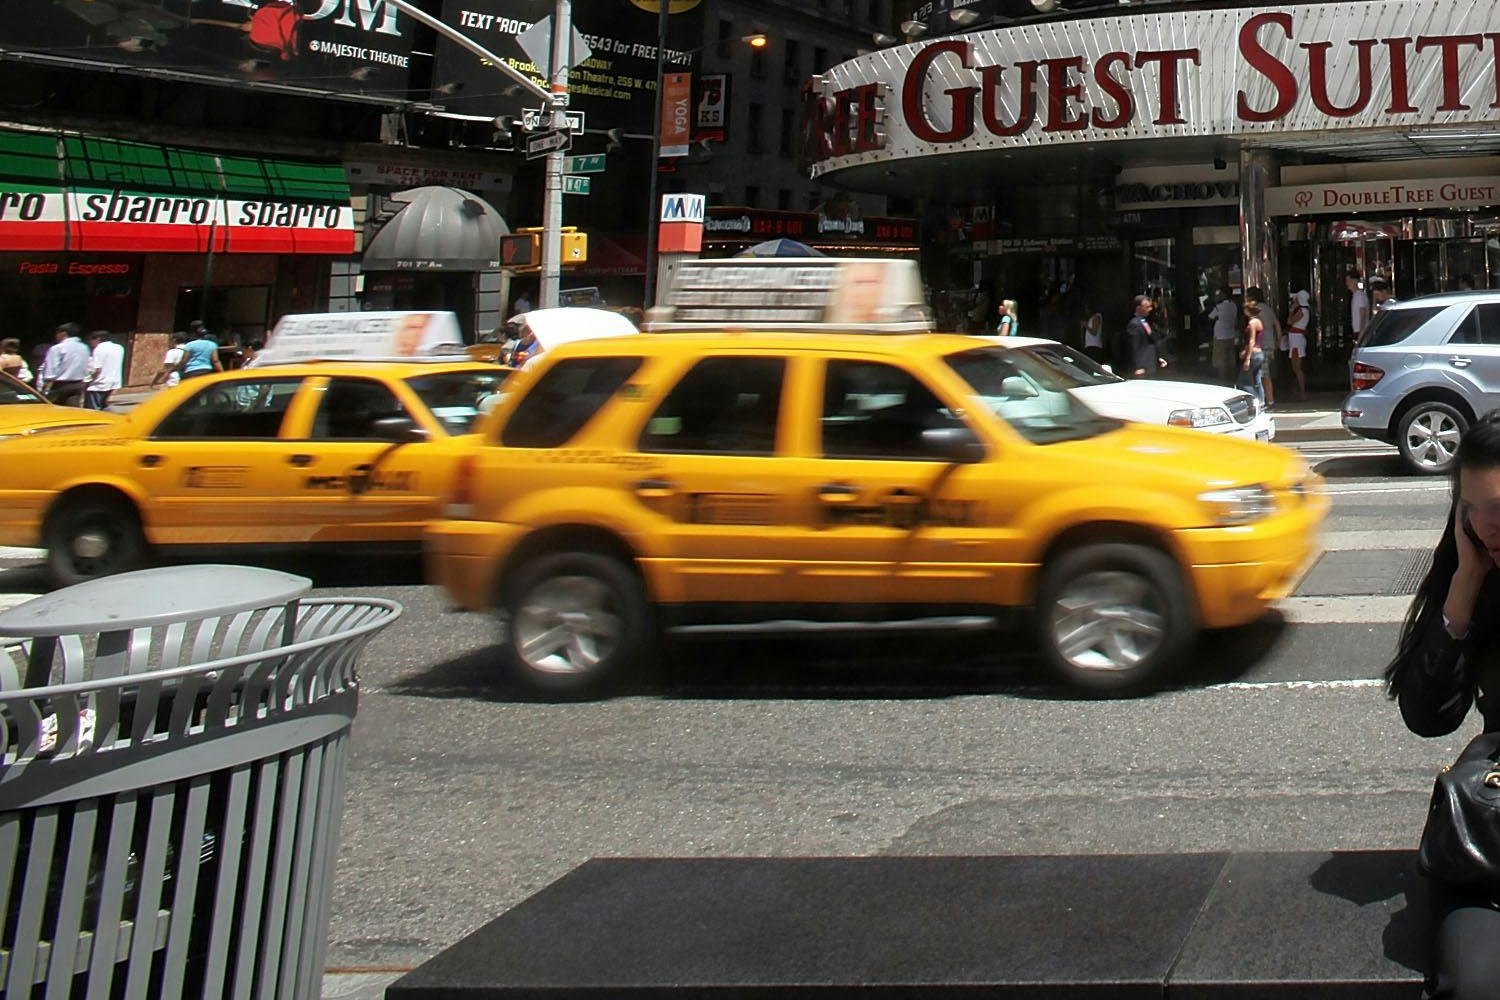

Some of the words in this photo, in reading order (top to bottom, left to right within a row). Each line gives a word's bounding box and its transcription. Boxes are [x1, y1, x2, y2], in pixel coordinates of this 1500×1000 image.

[461, 10, 494, 30] TEXT
[613, 41, 629, 55] for
[632, 42, 657, 60] FREE
[320, 40, 368, 61] MAJESTIC
[369, 48, 409, 69] THEATRE
[902, 39, 1199, 145] GUEST
[673, 98, 689, 134] YOGA
[377, 165, 419, 176] SPACE
[424, 169, 448, 178] FOR
[452, 171, 483, 180] RENT
[578, 157, 586, 171] 7
[1440, 183, 1494, 201] GUEST
[82, 188, 211, 226] sbarro
[239, 200, 341, 229] sbarro
[19, 262, 58, 274] Pasta
[67, 262, 129, 276] Espresso
